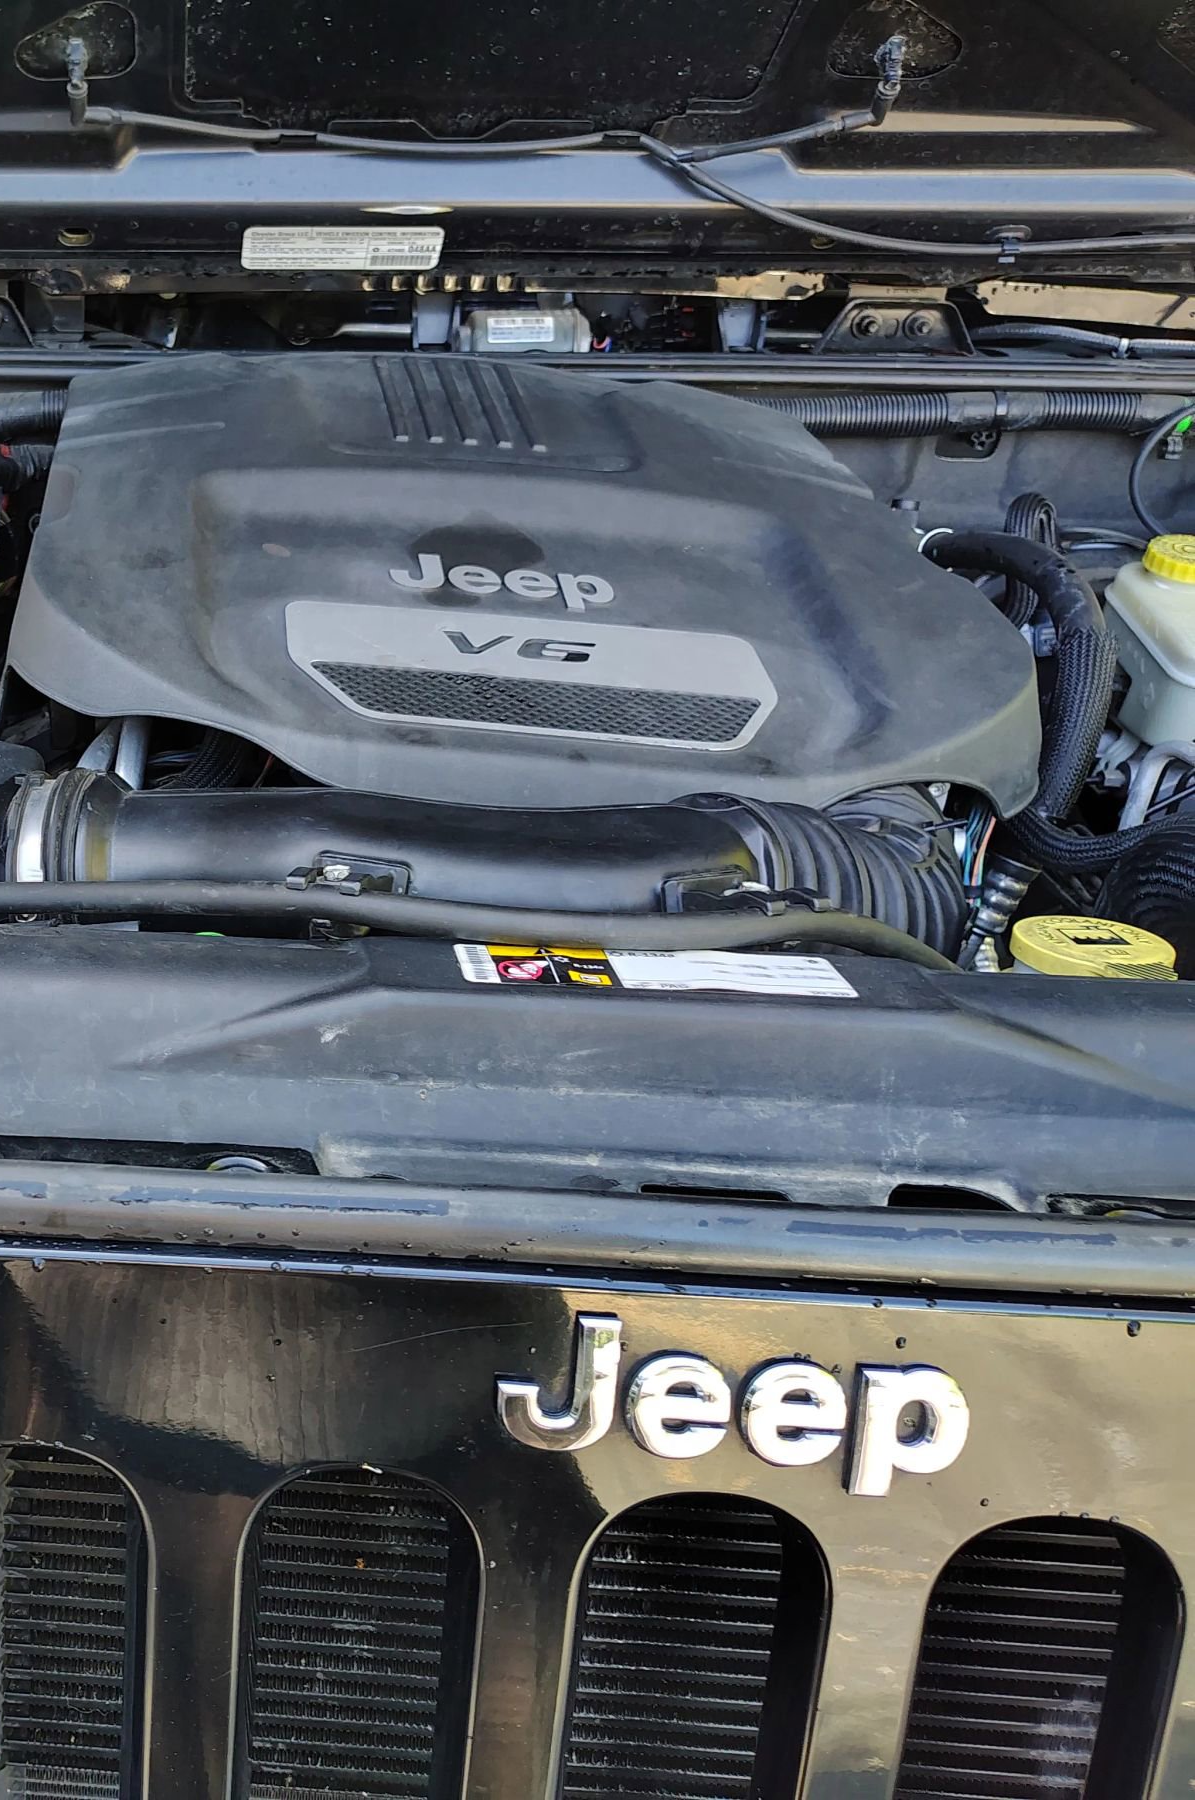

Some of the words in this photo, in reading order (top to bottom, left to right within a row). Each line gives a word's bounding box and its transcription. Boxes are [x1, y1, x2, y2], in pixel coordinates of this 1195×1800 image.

[388, 553, 615, 612] Jeep
[442, 629, 597, 663] V6
[494, 1311, 970, 1497] Jeep
